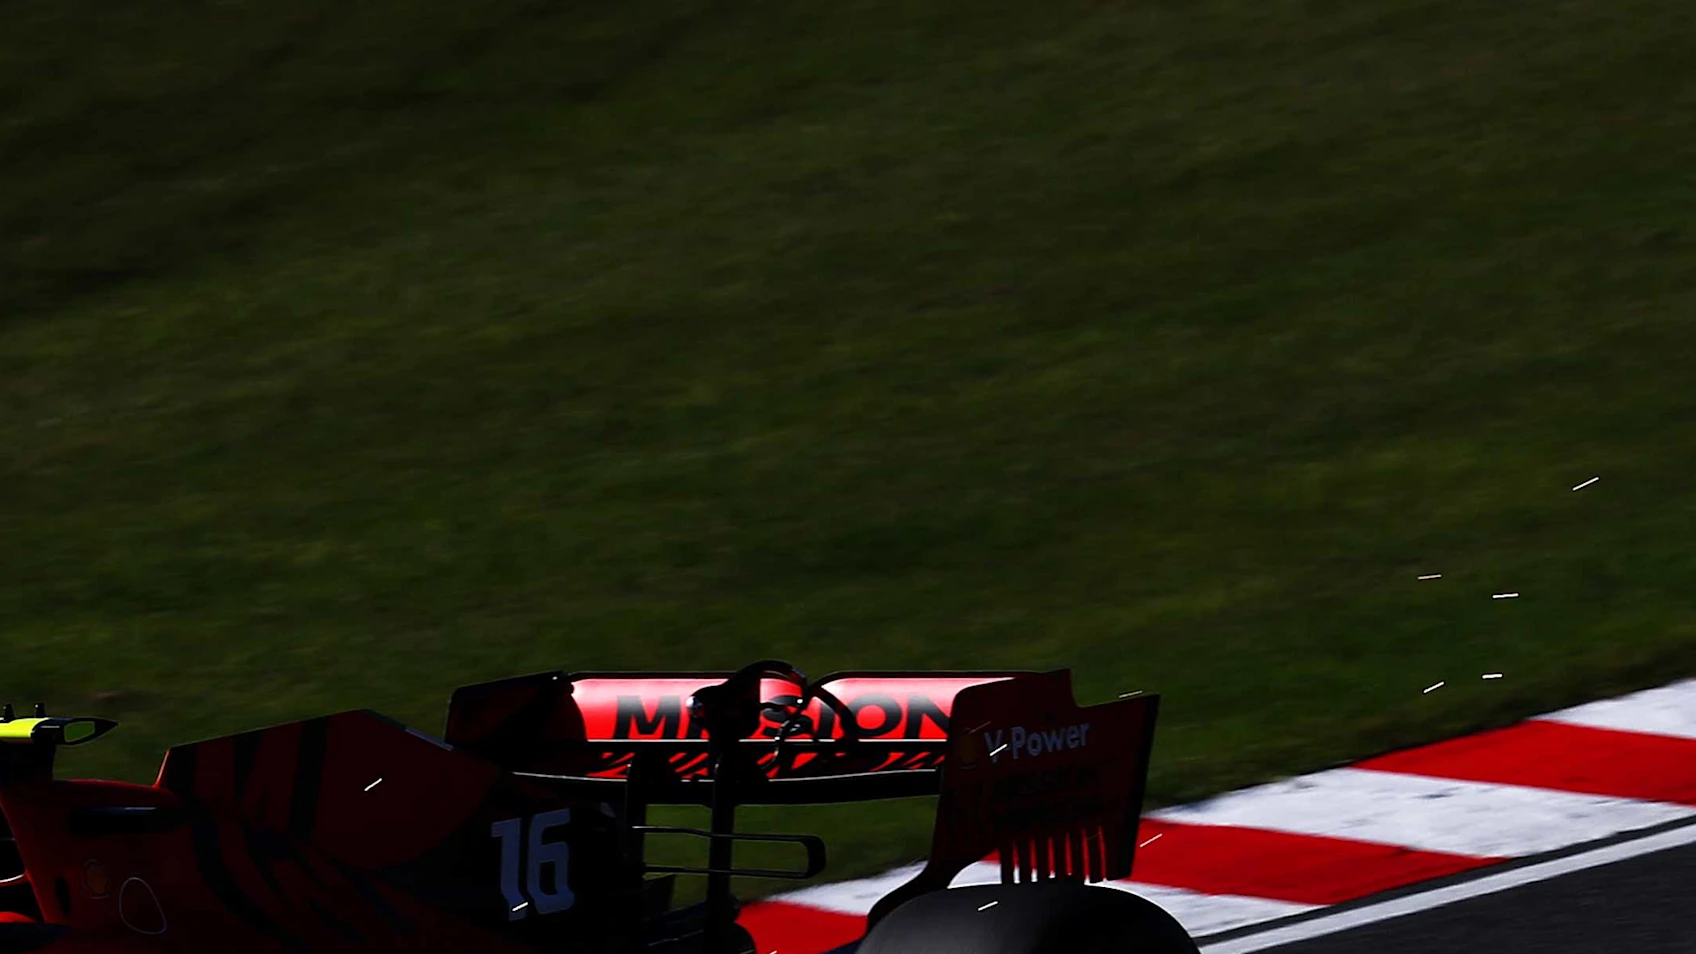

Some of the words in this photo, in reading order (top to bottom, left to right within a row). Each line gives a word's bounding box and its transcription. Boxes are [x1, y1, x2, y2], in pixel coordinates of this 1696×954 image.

[615, 694, 951, 740] MSION
[983, 722, 1091, 764] V-Power
[490, 807, 576, 922] 16
